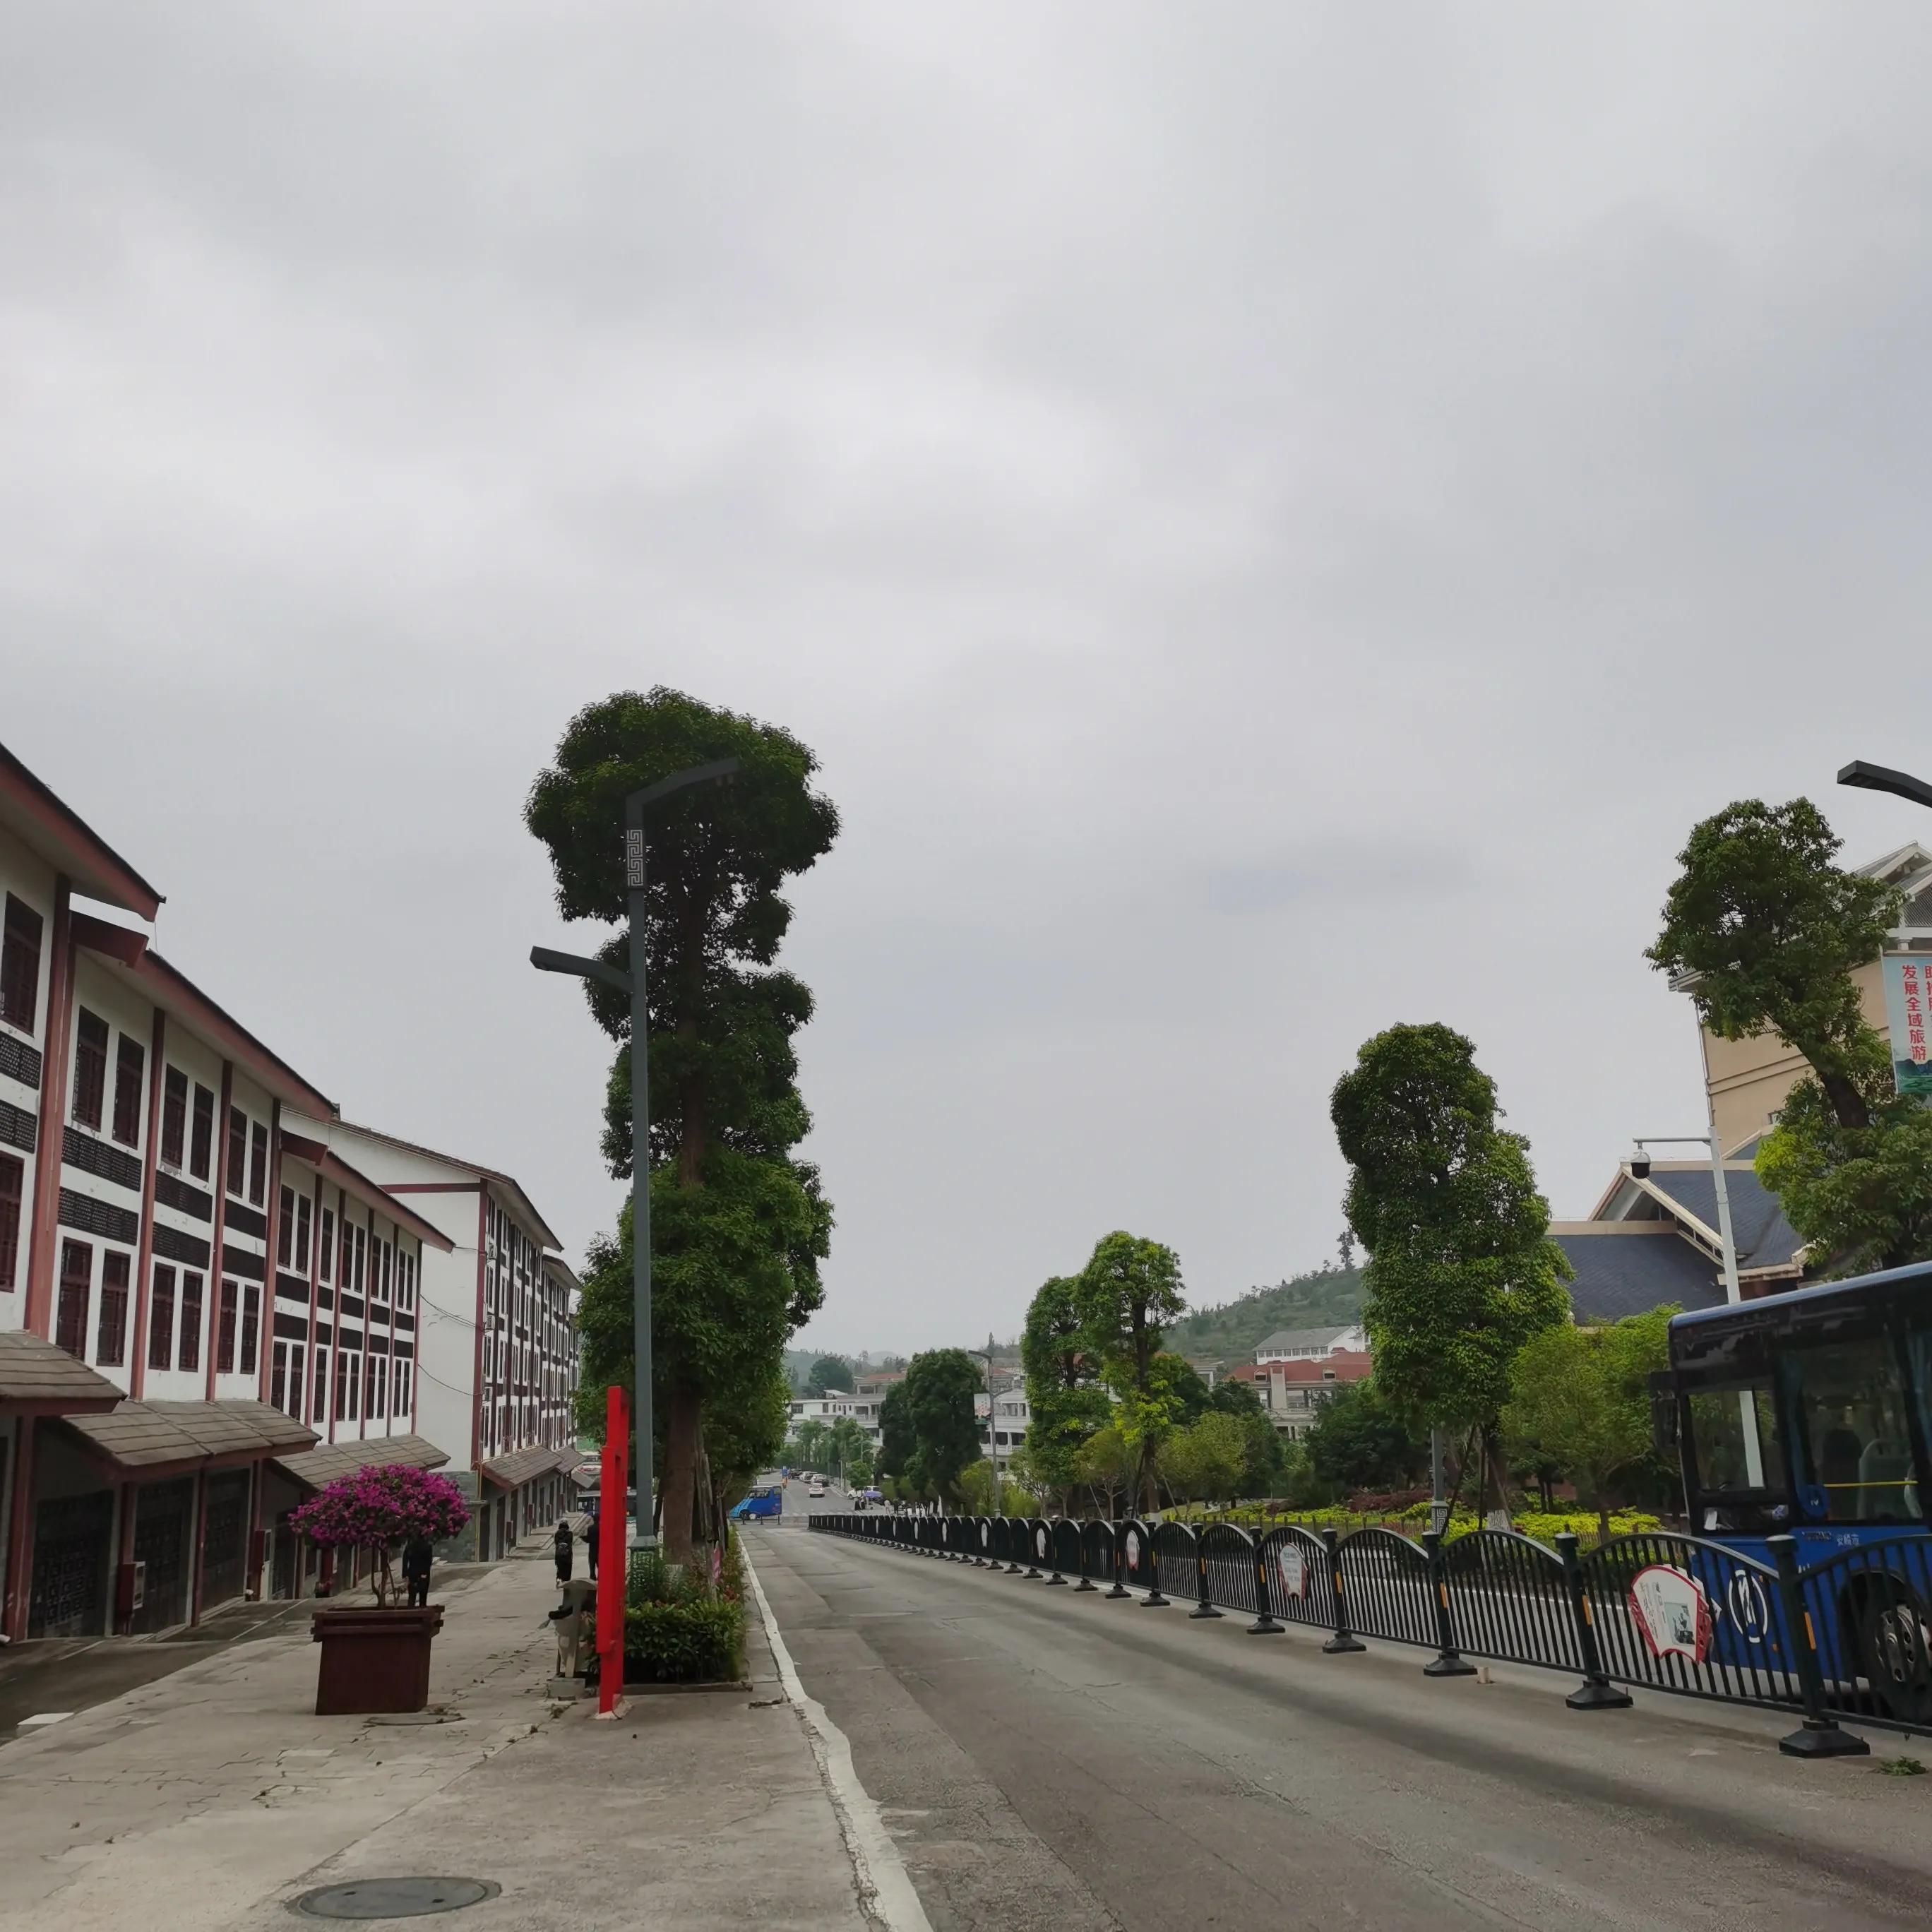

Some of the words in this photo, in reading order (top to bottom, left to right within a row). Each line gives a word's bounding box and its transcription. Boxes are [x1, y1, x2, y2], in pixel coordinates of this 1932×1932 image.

[1902, 965, 1926, 1060] 发展全域旅游
